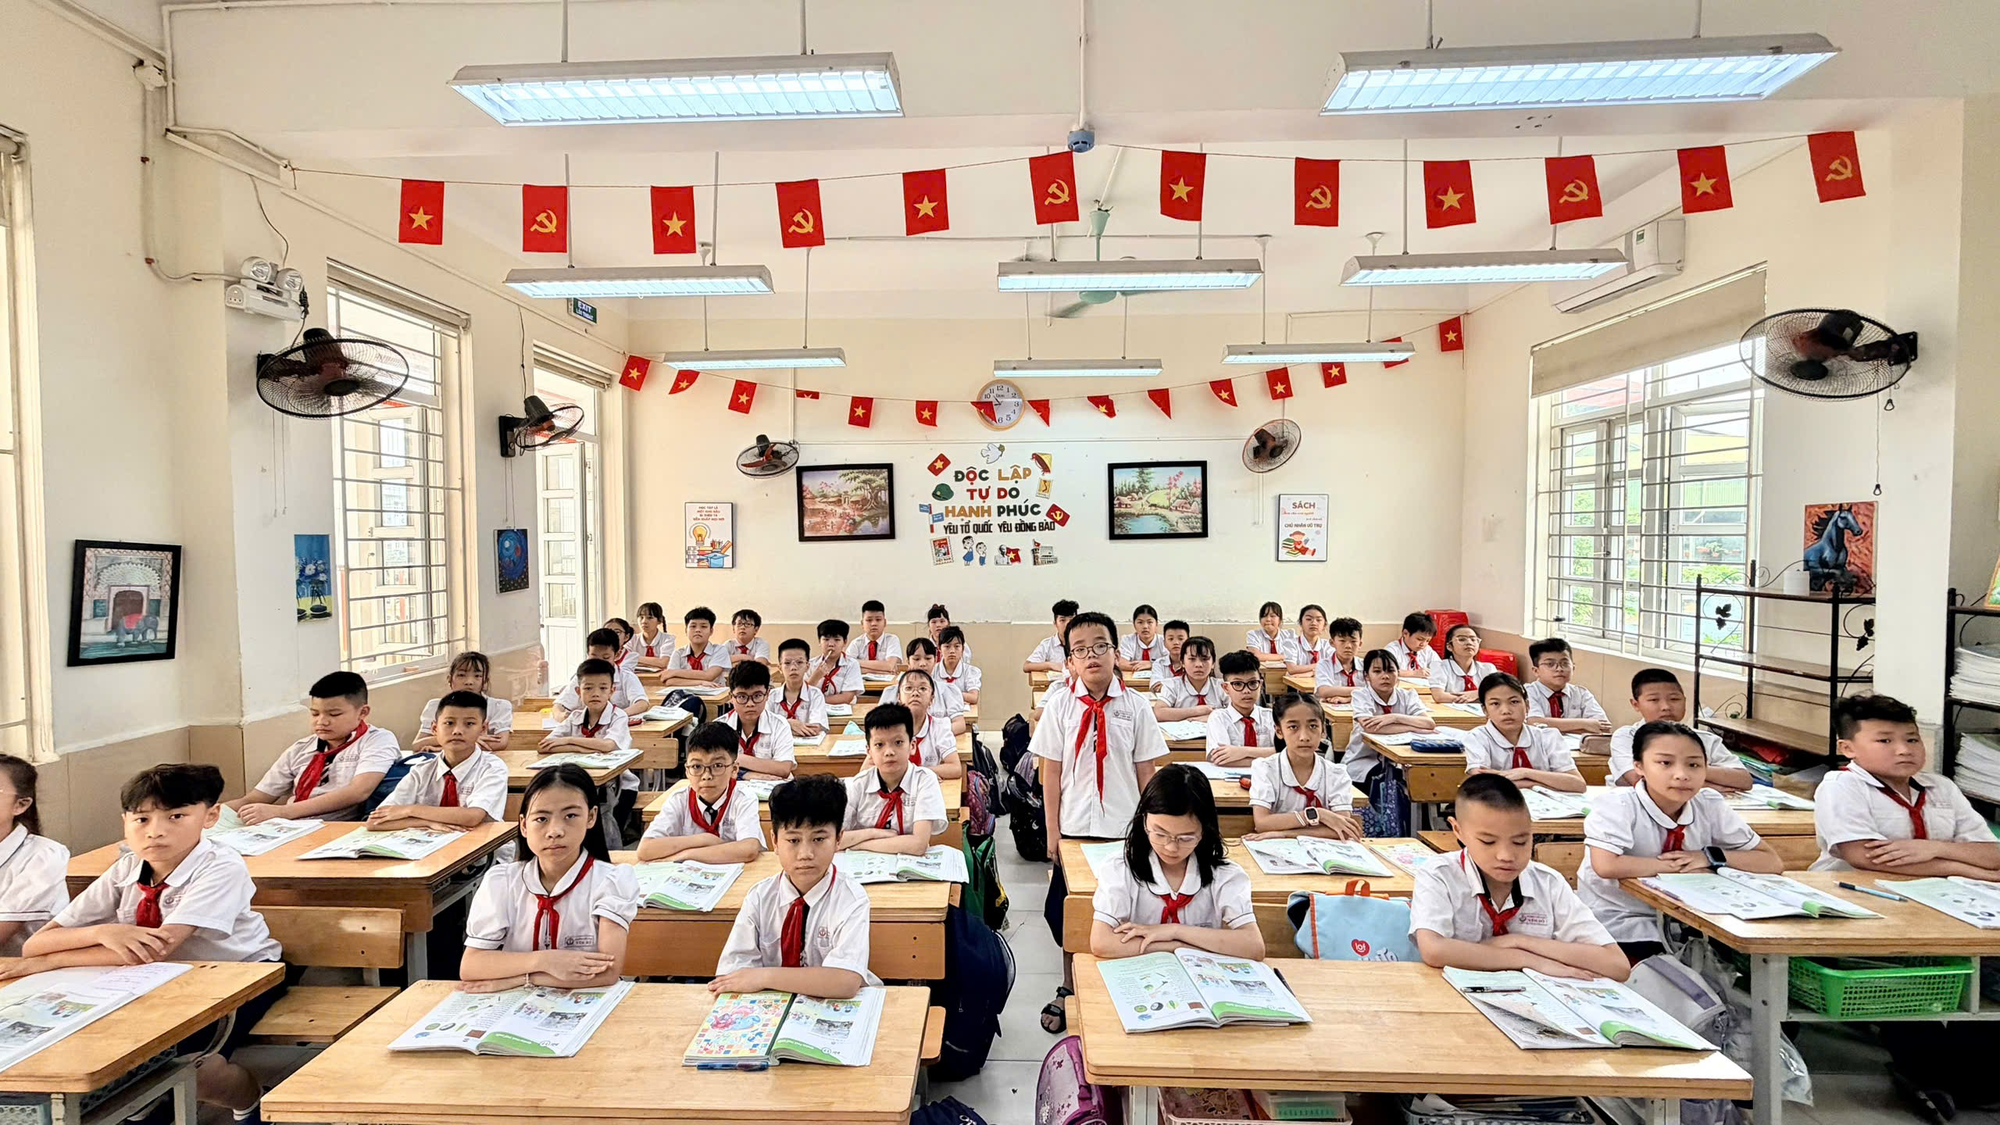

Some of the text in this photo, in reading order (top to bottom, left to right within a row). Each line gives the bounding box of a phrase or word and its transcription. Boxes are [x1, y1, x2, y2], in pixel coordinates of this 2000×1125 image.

[578, 301, 591, 313] EXIT
[954, 464, 1032, 485] ĐỘC LẬP
[966, 485, 1020, 503] TỰ DO
[944, 499, 1042, 521] HẠNH PHÚC
[1292, 501, 1315, 509] SÁCH
[943, 521, 958, 535] YÊU
[973, 519, 993, 534] QUỐC
[998, 520, 1012, 533] YÊU
[1014, 519, 1037, 533] ĐỒNG
[1038, 518, 1056, 531] BÀO
